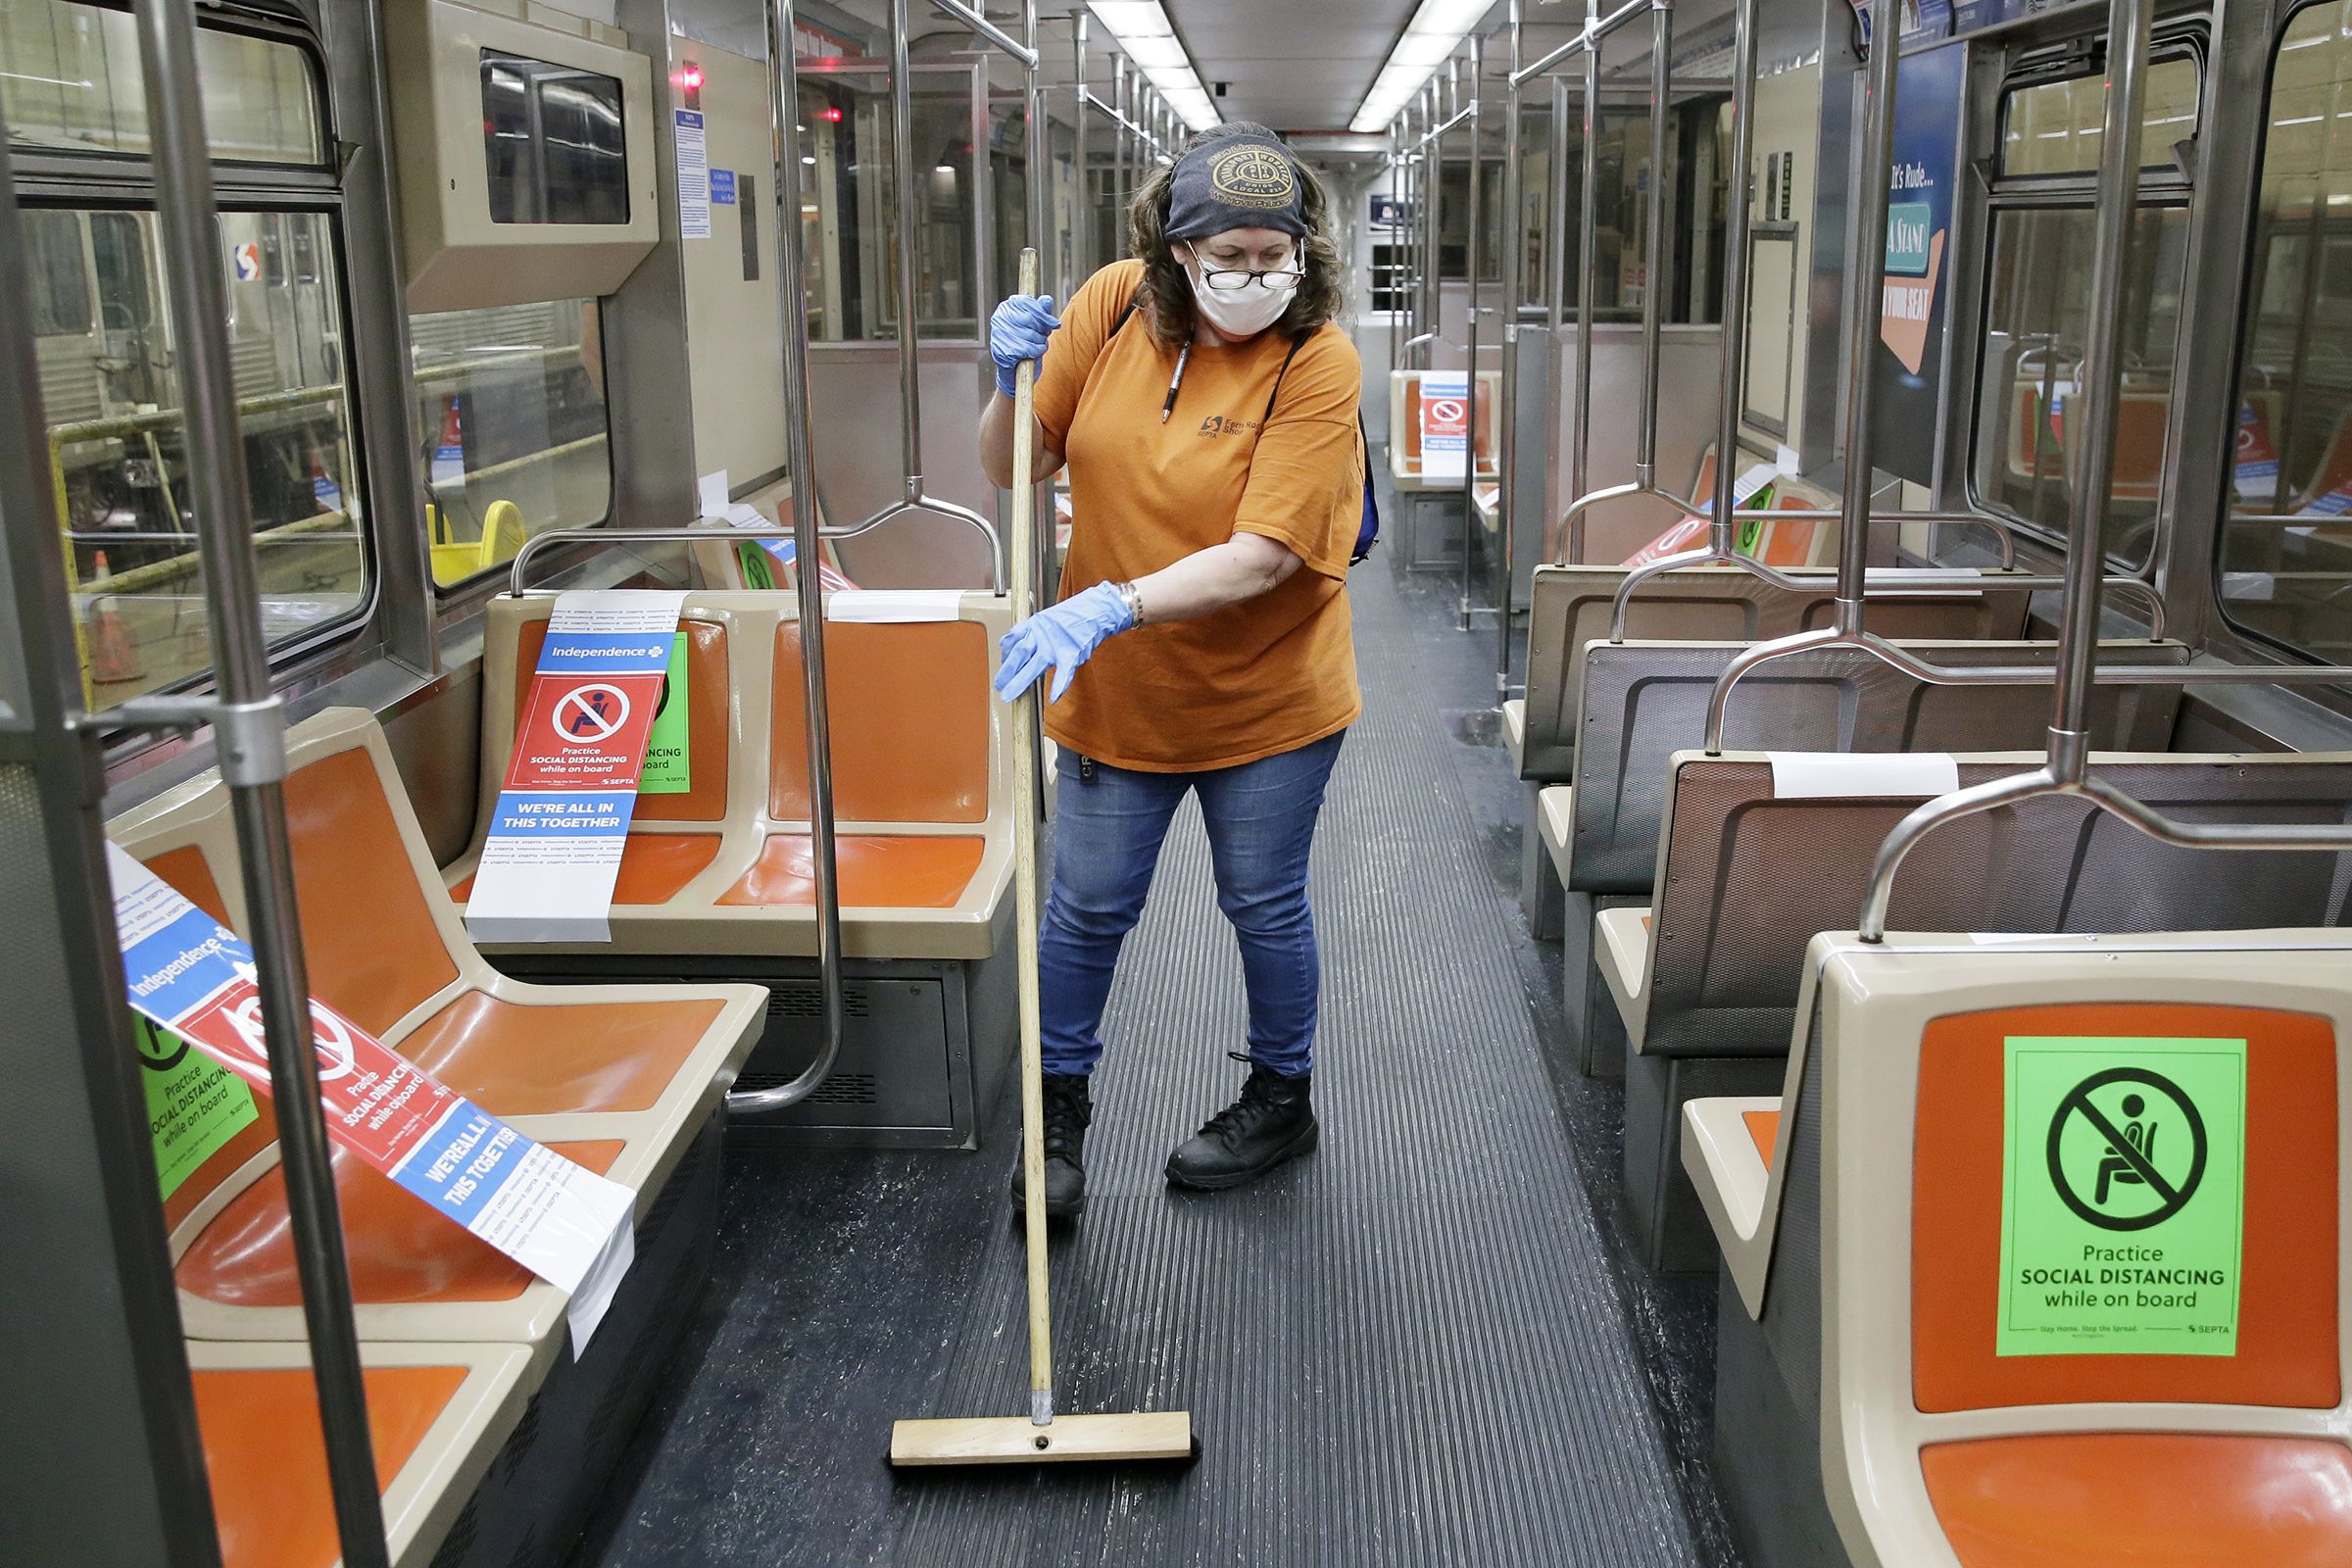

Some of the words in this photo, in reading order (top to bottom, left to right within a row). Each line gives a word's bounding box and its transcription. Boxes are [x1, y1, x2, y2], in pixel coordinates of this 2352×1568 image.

[1891, 164, 1904, 189] It's
[1905, 161, 1934, 188] Rude...
[1887, 285, 1907, 318] YOUR
[1908, 287, 1929, 321] SEAT
[552, 647, 646, 659] Independence
[562, 747, 601, 756] Practice
[517, 803, 565, 813] WE'RE
[567, 803, 595, 813] ALL
[598, 803, 614, 813] IN
[504, 817, 537, 829] THIS
[540, 816, 620, 829] TOGETHER
[128, 935, 221, 998] Independence
[165, 1066, 201, 1099] Practice
[152, 1104, 180, 1135] OCIAL
[163, 1122, 186, 1149] while
[187, 1111, 201, 1127] on
[200, 1084, 228, 1116] board
[342, 1098, 377, 1127] SOCIAL
[443, 1175, 478, 1206] THIS
[2083, 1245, 2164, 1261] Practice
[2020, 1269, 2094, 1285] SOCIAL
[2100, 1269, 2225, 1286] DISTANCING
[2045, 1290, 2097, 1307] while
[2104, 1294, 2130, 1307] on
[2136, 1290, 2197, 1308] board
[2198, 1325, 2230, 1334] SEPTA
